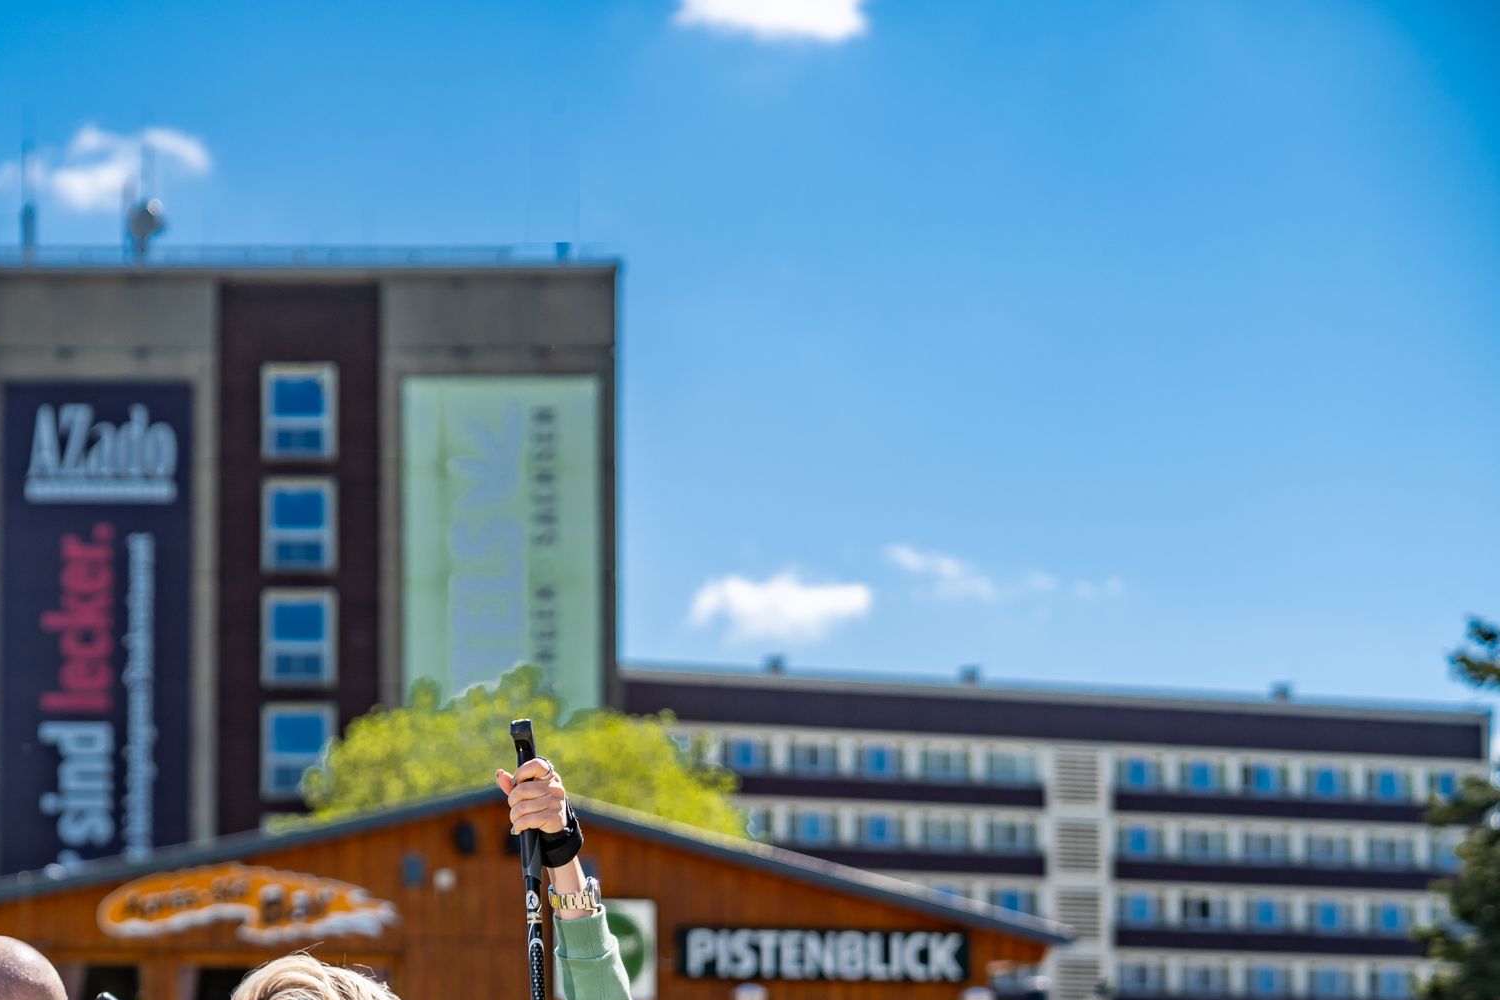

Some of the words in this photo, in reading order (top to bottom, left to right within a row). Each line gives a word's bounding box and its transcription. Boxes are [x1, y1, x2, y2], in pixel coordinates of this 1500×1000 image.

[27, 402, 179, 482] AZado
[39, 521, 116, 713] lecker.
[38, 720, 116, 847] sind
[685, 926, 965, 983] PISTENBLICK
